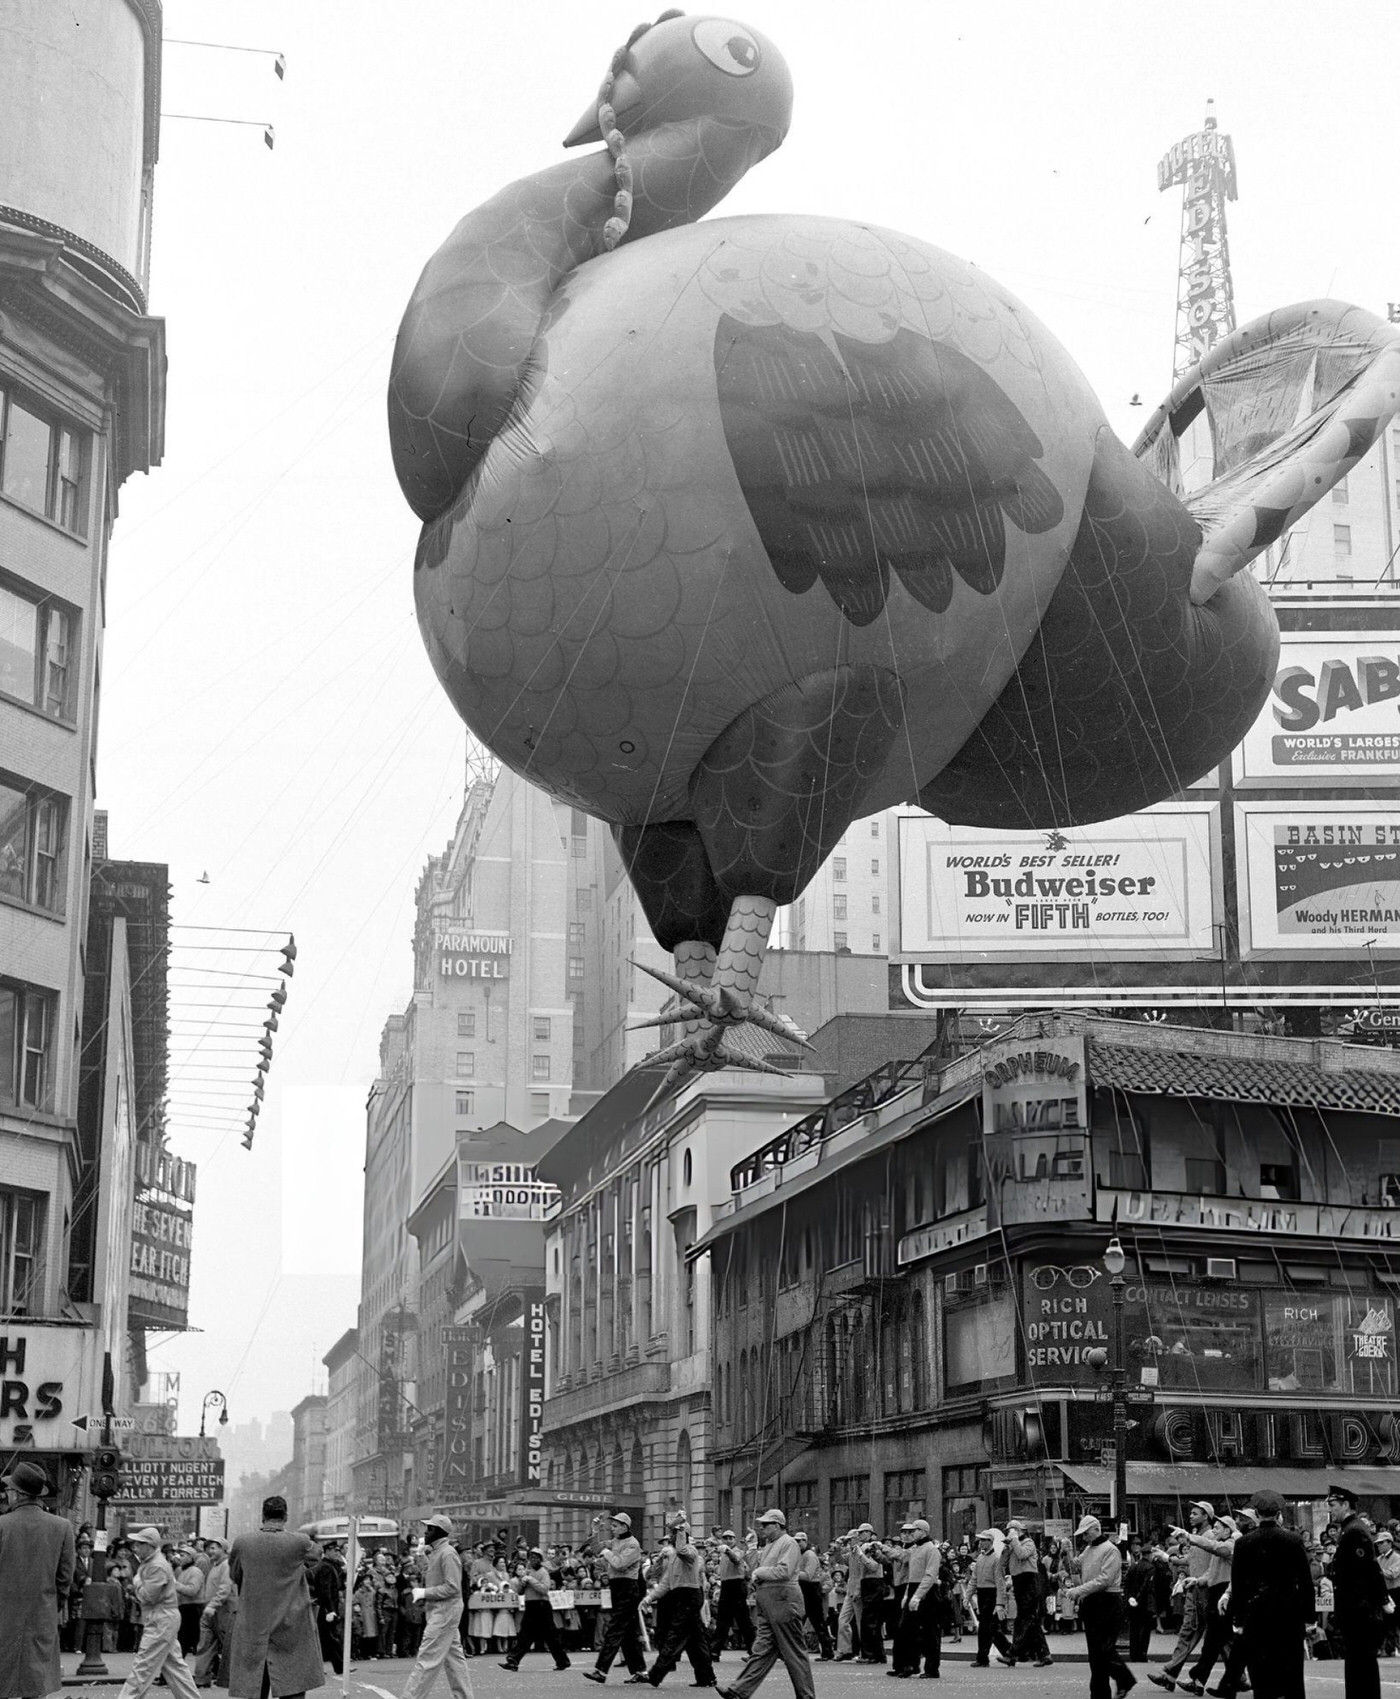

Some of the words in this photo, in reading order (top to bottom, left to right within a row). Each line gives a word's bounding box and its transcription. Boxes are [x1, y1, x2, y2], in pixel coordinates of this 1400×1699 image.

[1157, 131, 1227, 192] HOTEL
[1272, 656, 1400, 732] SAB
[1283, 736, 1342, 748] WORLD'S
[1349, 736, 1400, 748] LARGES
[1291, 751, 1337, 761] Exclusive
[1287, 825, 1362, 845] BASIN
[946, 853, 1012, 868] WORLD'S
[1019, 855, 1055, 868] BEST
[1061, 854, 1120, 868] SELLER!
[964, 869, 1156, 898] Budweiser
[965, 913, 995, 923] NOW
[996, 913, 1010, 923] IN
[1095, 911, 1139, 922] BOTTLES,
[1142, 911, 1169, 921] TOO!
[1295, 909, 1338, 926] Woody
[1311, 925, 1327, 934] and
[1329, 925, 1342, 934] his
[1344, 925, 1365, 934] Third
[435, 934, 515, 955] PARAMOUNT
[441, 959, 504, 978] HOTEL
[984, 1051, 1081, 1089] ORPHEUM
[135, 1142, 197, 1204] ULTON
[133, 1200, 149, 1235] HE
[151, 1209, 193, 1249] SEVEN
[131, 1241, 157, 1277] EAR
[160, 1249, 188, 1287] ITCH
[1041, 1297, 1088, 1314] RICH
[1125, 1286, 1189, 1305] CONTACT
[1195, 1291, 1249, 1310] LENSES
[1284, 1307, 1318, 1320] RICH
[442, 1329, 479, 1343] Hotel
[1028, 1320, 1109, 1340] OPTICAL
[528, 1303, 543, 1378] HOTEL
[0, 1380, 63, 1419] RS
[450, 1350, 469, 1477] EDISON
[114, 1419, 134, 1428] WAY
[427, 1416, 436, 1449] BLUE
[528, 1388, 542, 1480] EDISON
[123, 1437, 217, 1459] ULTON
[117, 1462, 167, 1474] LLIOTT
[170, 1462, 216, 1474] NUGENT
[122, 1475, 159, 1486] EVEN
[161, 1475, 194, 1486] YEAR
[197, 1475, 224, 1486] ITCH
[113, 1487, 155, 1499] SALLY
[162, 1487, 216, 1499] FORREST
[556, 1493, 613, 1504] GLOBE
[481, 1593, 505, 1603] POLICE
[1315, 1598, 1333, 1606] OLICE
